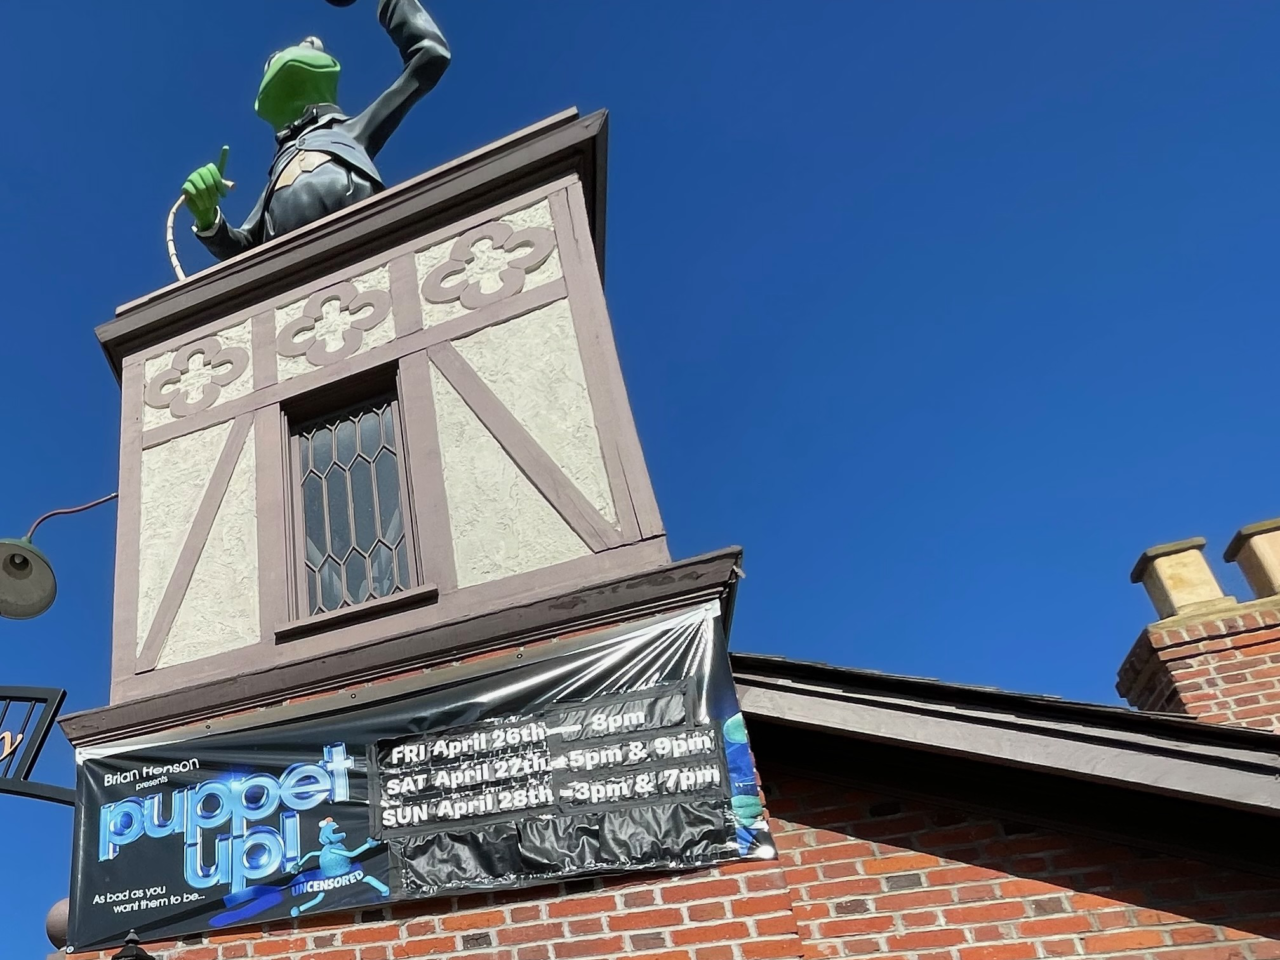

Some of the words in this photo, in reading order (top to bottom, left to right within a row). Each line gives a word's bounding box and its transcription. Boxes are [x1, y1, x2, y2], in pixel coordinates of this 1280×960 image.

[392, 744, 426, 764] FRI
[432, 733, 487, 758] April
[492, 723, 545, 747] 26th
[592, 711, 645, 731] 8pm
[104, 769, 139, 786] Brian
[142, 758, 199, 777] Henson
[136, 775, 168, 791] presents
[387, 774, 428, 795] SAT
[435, 763, 489, 788] April
[495, 755, 548, 777] 27th
[628, 742, 647, 760] &
[654, 735, 712, 757] 9pm
[99, 742, 354, 862] puppet
[382, 805, 428, 826] SUN
[438, 794, 493, 818] April
[499, 785, 553, 808] 28th
[635, 775, 654, 793] &
[663, 768, 720, 790] 7pm
[184, 811, 300, 893] up!
[93, 894, 105, 904] As
[107, 890, 129, 902] bad
[131, 889, 144, 898] as
[145, 886, 166, 898] you
[292, 870, 364, 897] UNCENSORED
[113, 901, 139, 913] want
[141, 896, 168, 907] them
[170, 895, 181, 904] to
